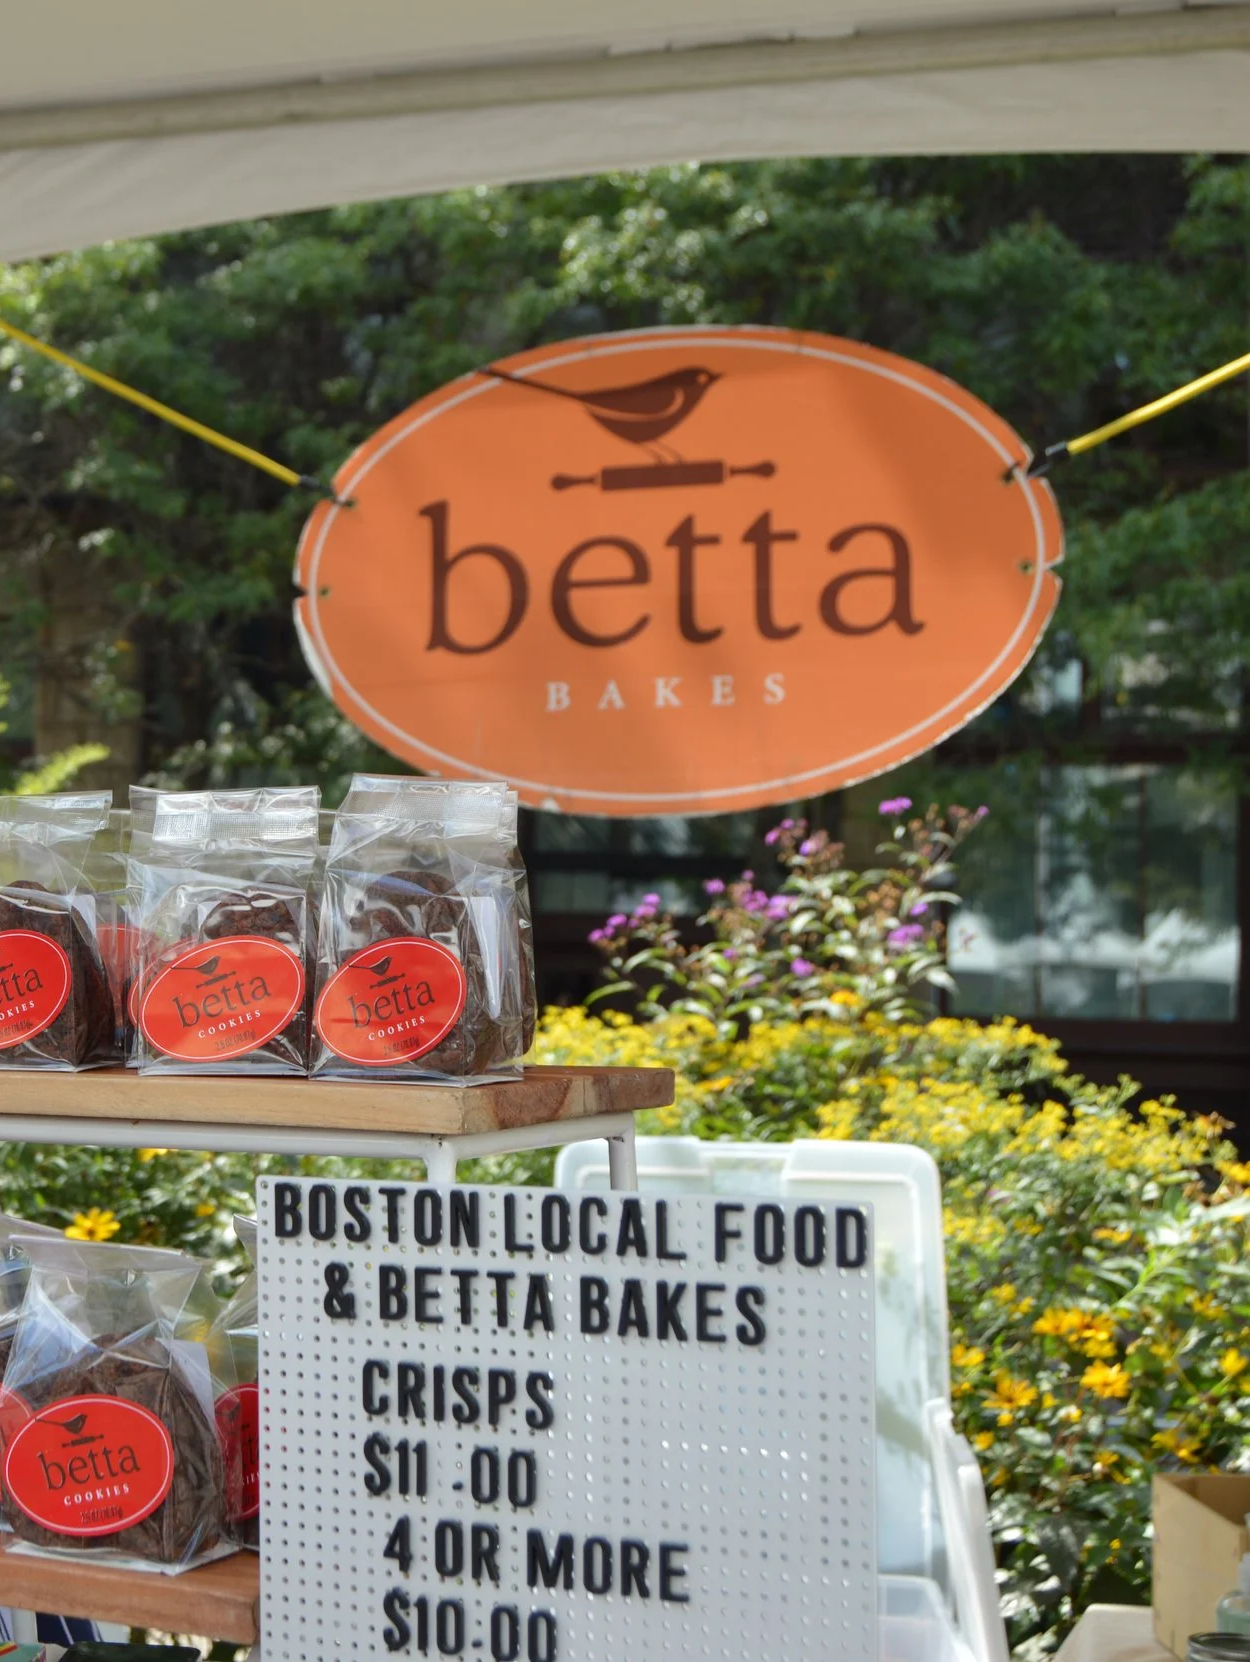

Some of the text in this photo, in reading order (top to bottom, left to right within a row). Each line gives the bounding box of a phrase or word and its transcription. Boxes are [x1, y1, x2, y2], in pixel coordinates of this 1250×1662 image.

[418, 500, 925, 656] betta
[546, 672, 786, 712] BAKES
[172, 976, 271, 1028] betta
[198, 1009, 262, 1039] COOKIES
[348, 980, 436, 1029] betta
[367, 1015, 426, 1041] COOKIES
[274, 1182, 867, 1269] BOSTON LOCAL FOOD
[323, 1261, 766, 1346] & BETTA BAKES
[362, 1359, 554, 1429] CRISPS
[36, 1444, 141, 1491] betta
[63, 1482, 130, 1507] COOKIES
[383, 1514, 690, 1603] 4 OR MORE
[382, 1587, 557, 1662] $10.00
